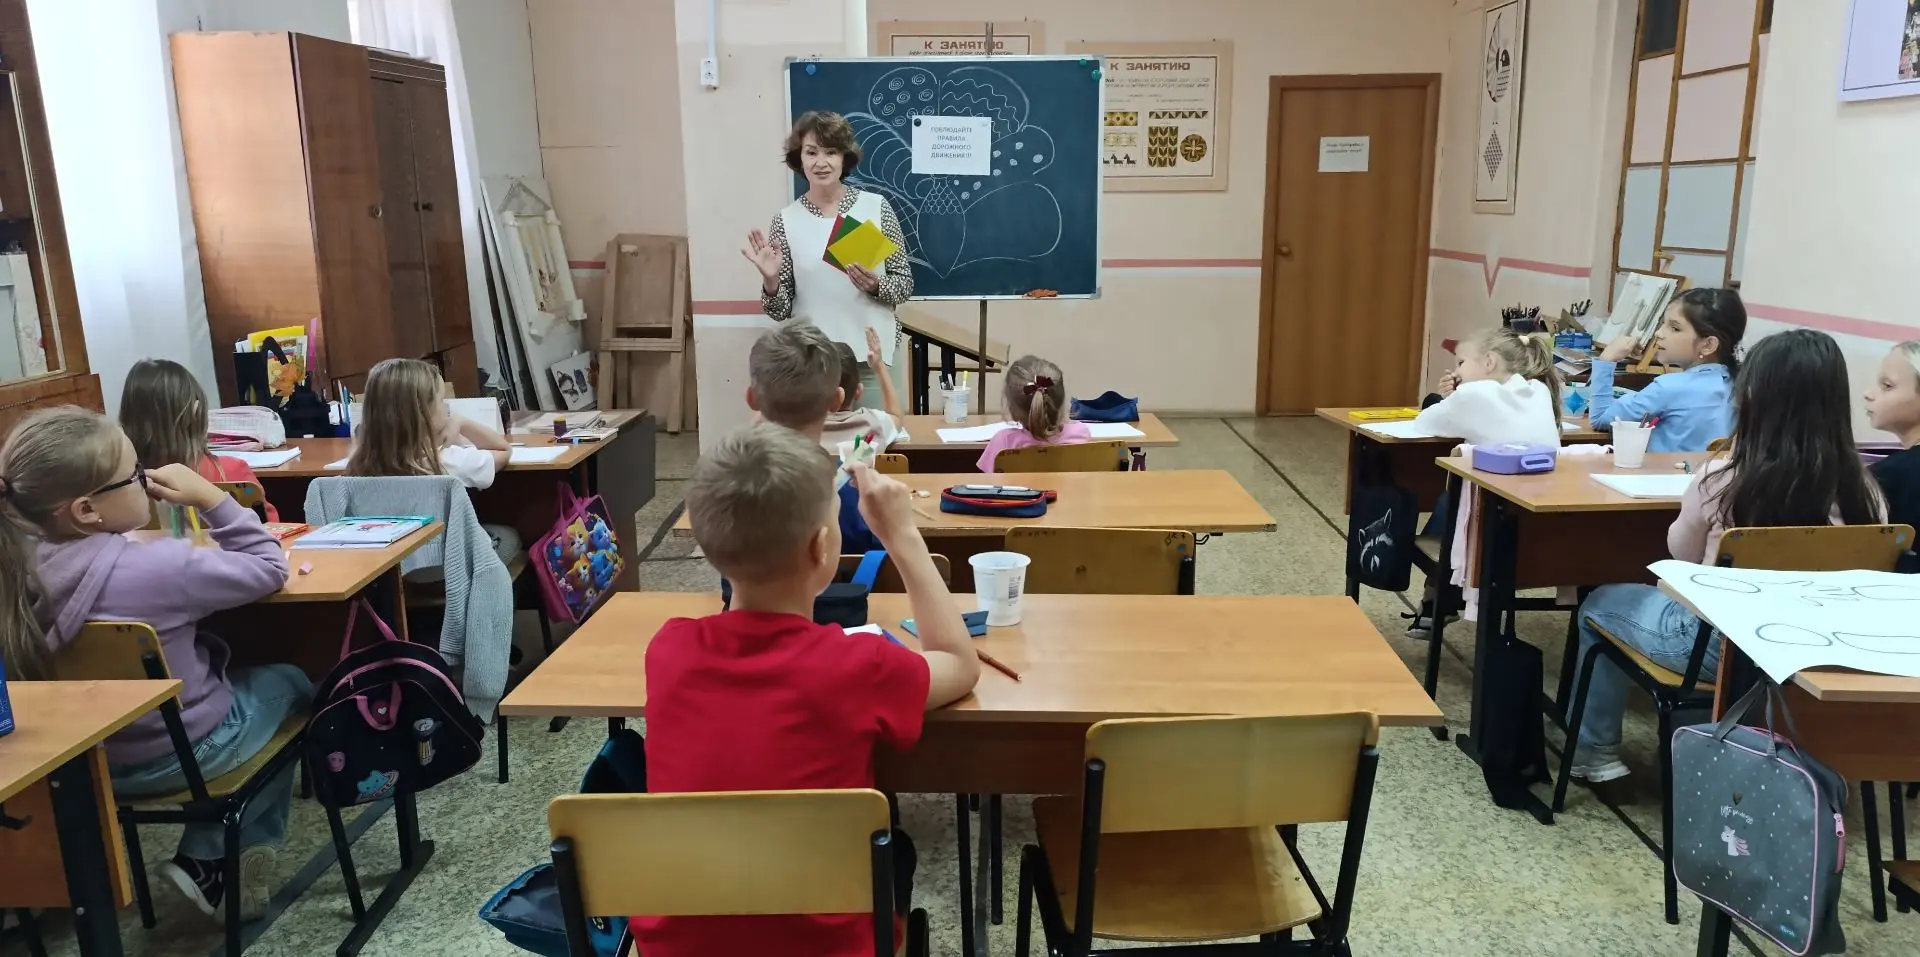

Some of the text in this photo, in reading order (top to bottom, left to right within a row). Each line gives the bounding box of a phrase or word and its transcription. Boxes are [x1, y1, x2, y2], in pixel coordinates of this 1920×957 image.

[924, 41, 1004, 49] К ЗАНЯТЮ
[1126, 62, 1191, 71] ЗАНЯТИЮ
